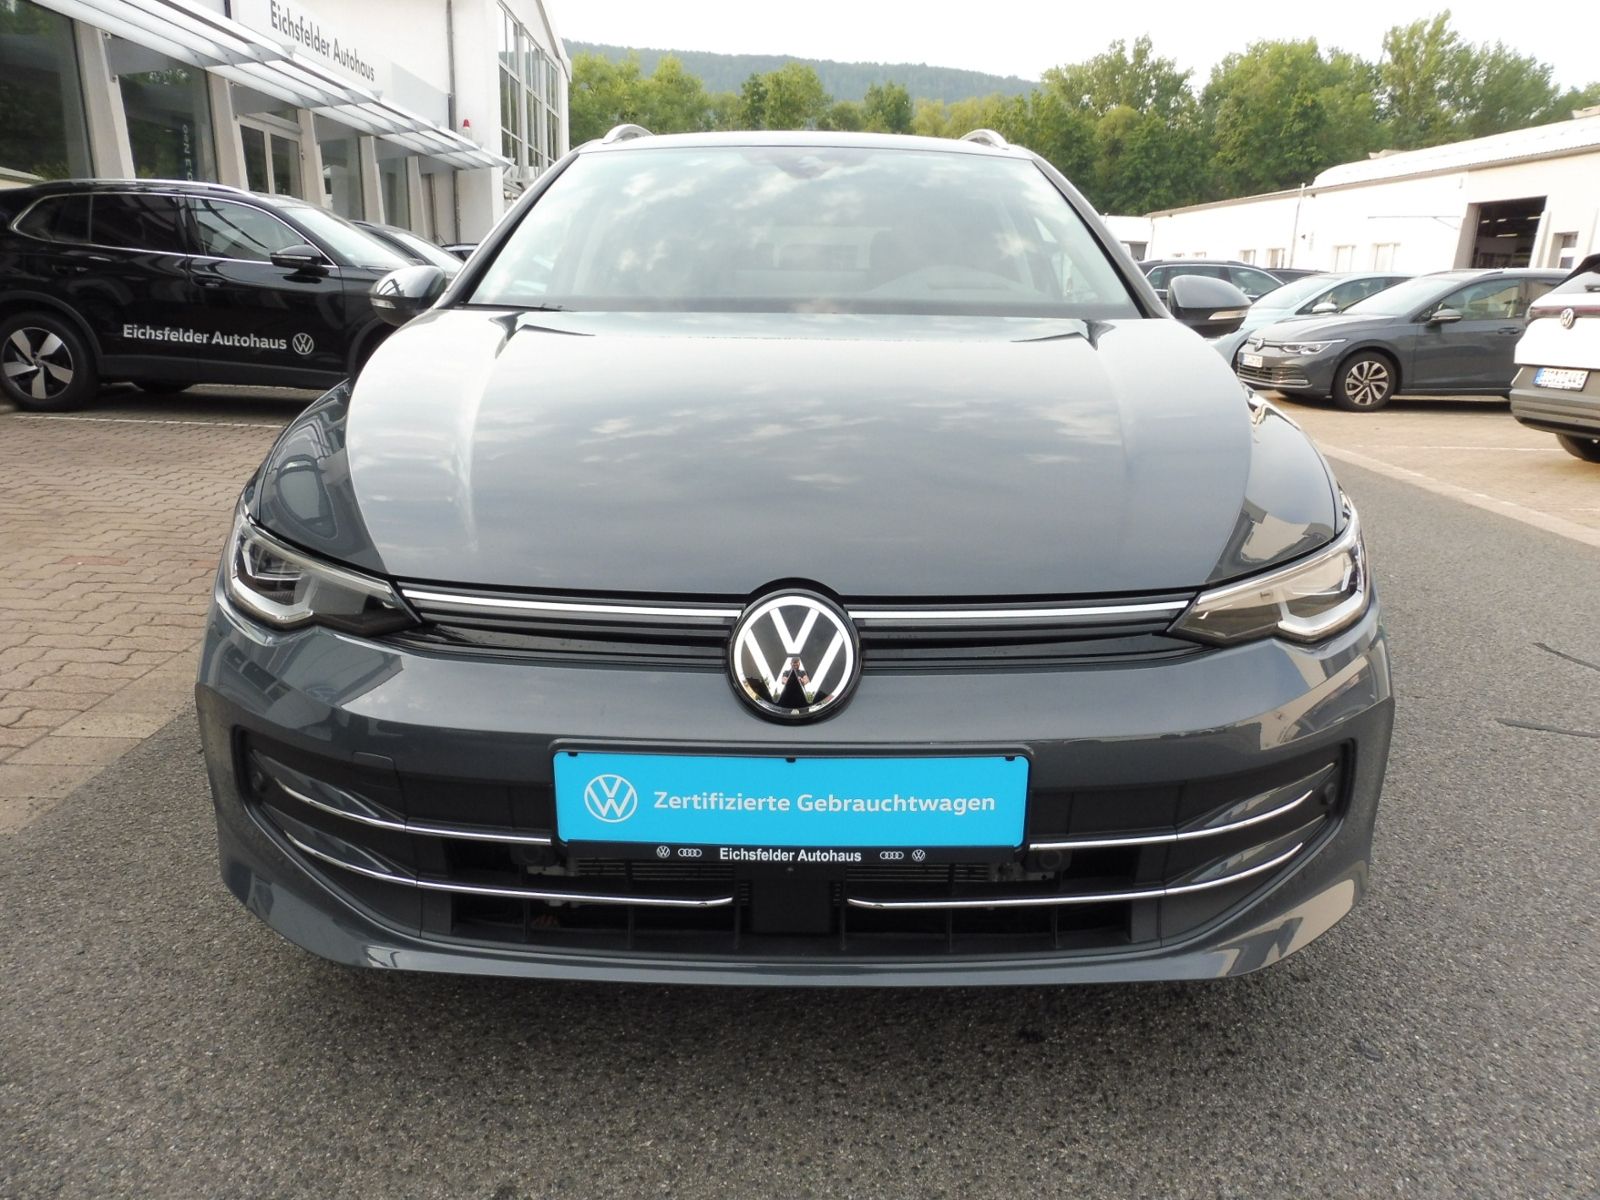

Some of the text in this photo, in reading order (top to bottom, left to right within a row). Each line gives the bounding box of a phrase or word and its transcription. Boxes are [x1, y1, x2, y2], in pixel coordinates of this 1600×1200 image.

[270, 0, 375, 82] Eichsfelder Autohaus
[123, 324, 209, 344] Eichsfelder
[211, 331, 288, 350] Autohaus
[654, 791, 791, 811] Zertifizierte
[797, 794, 995, 815] Gebrauchtwagen
[719, 847, 796, 861] Eichsfelder
[797, 849, 862, 862] Autohaus
